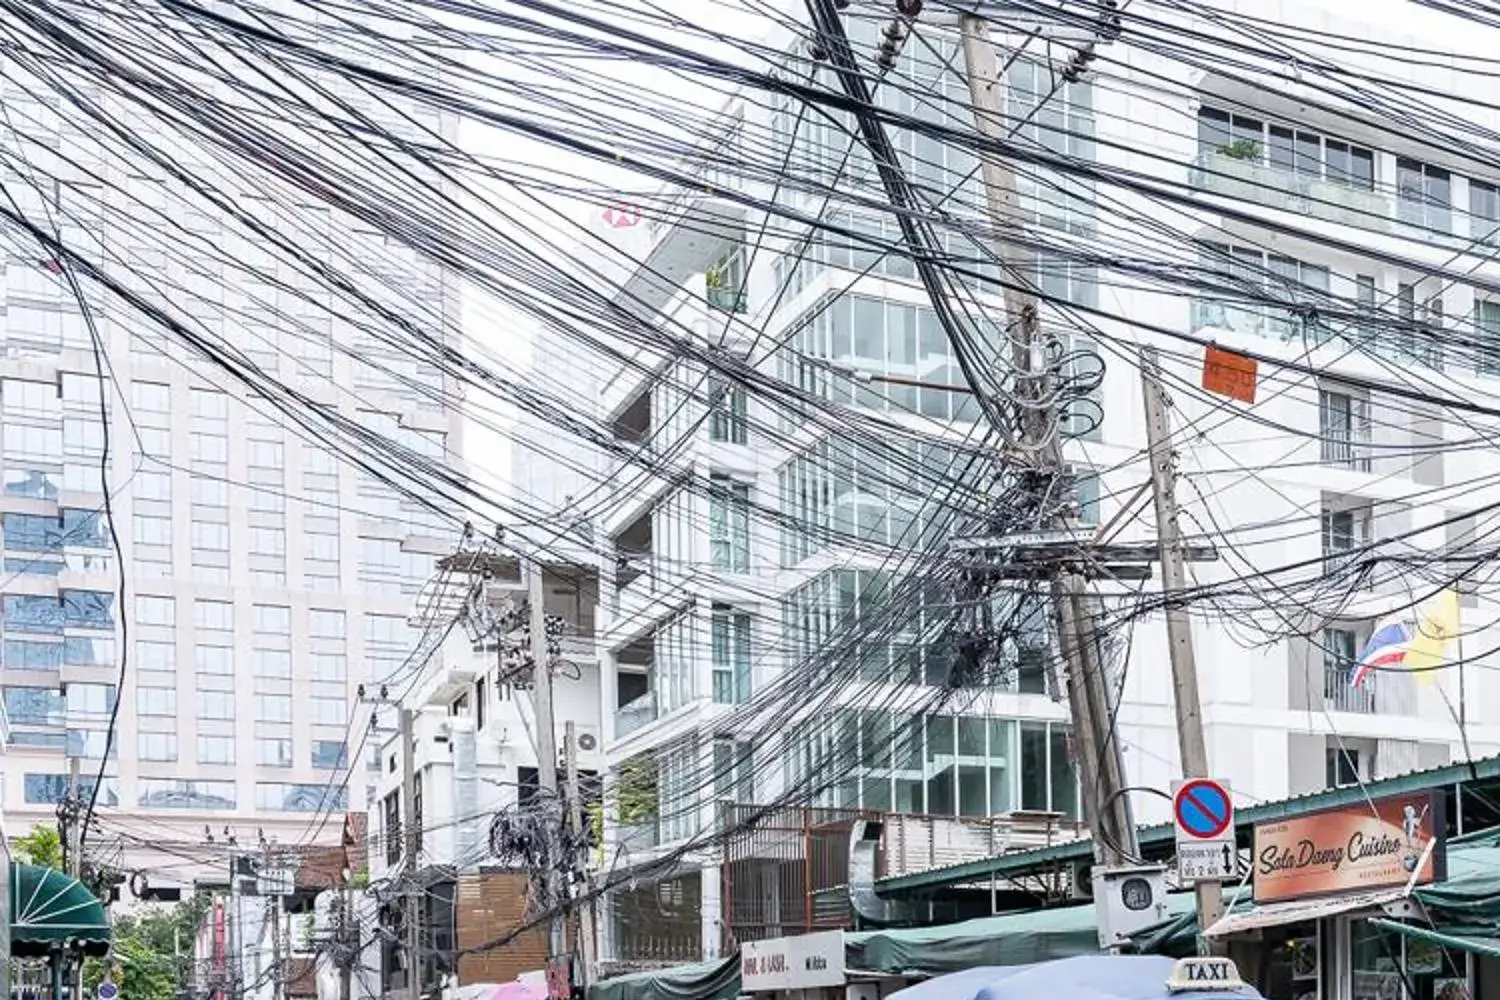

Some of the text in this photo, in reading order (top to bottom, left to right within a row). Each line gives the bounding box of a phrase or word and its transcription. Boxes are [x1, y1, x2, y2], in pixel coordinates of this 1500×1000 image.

[1259, 845, 1296, 875] Sala
[1347, 831, 1401, 863] Cuisine
[1185, 963, 1229, 980] TAXI
